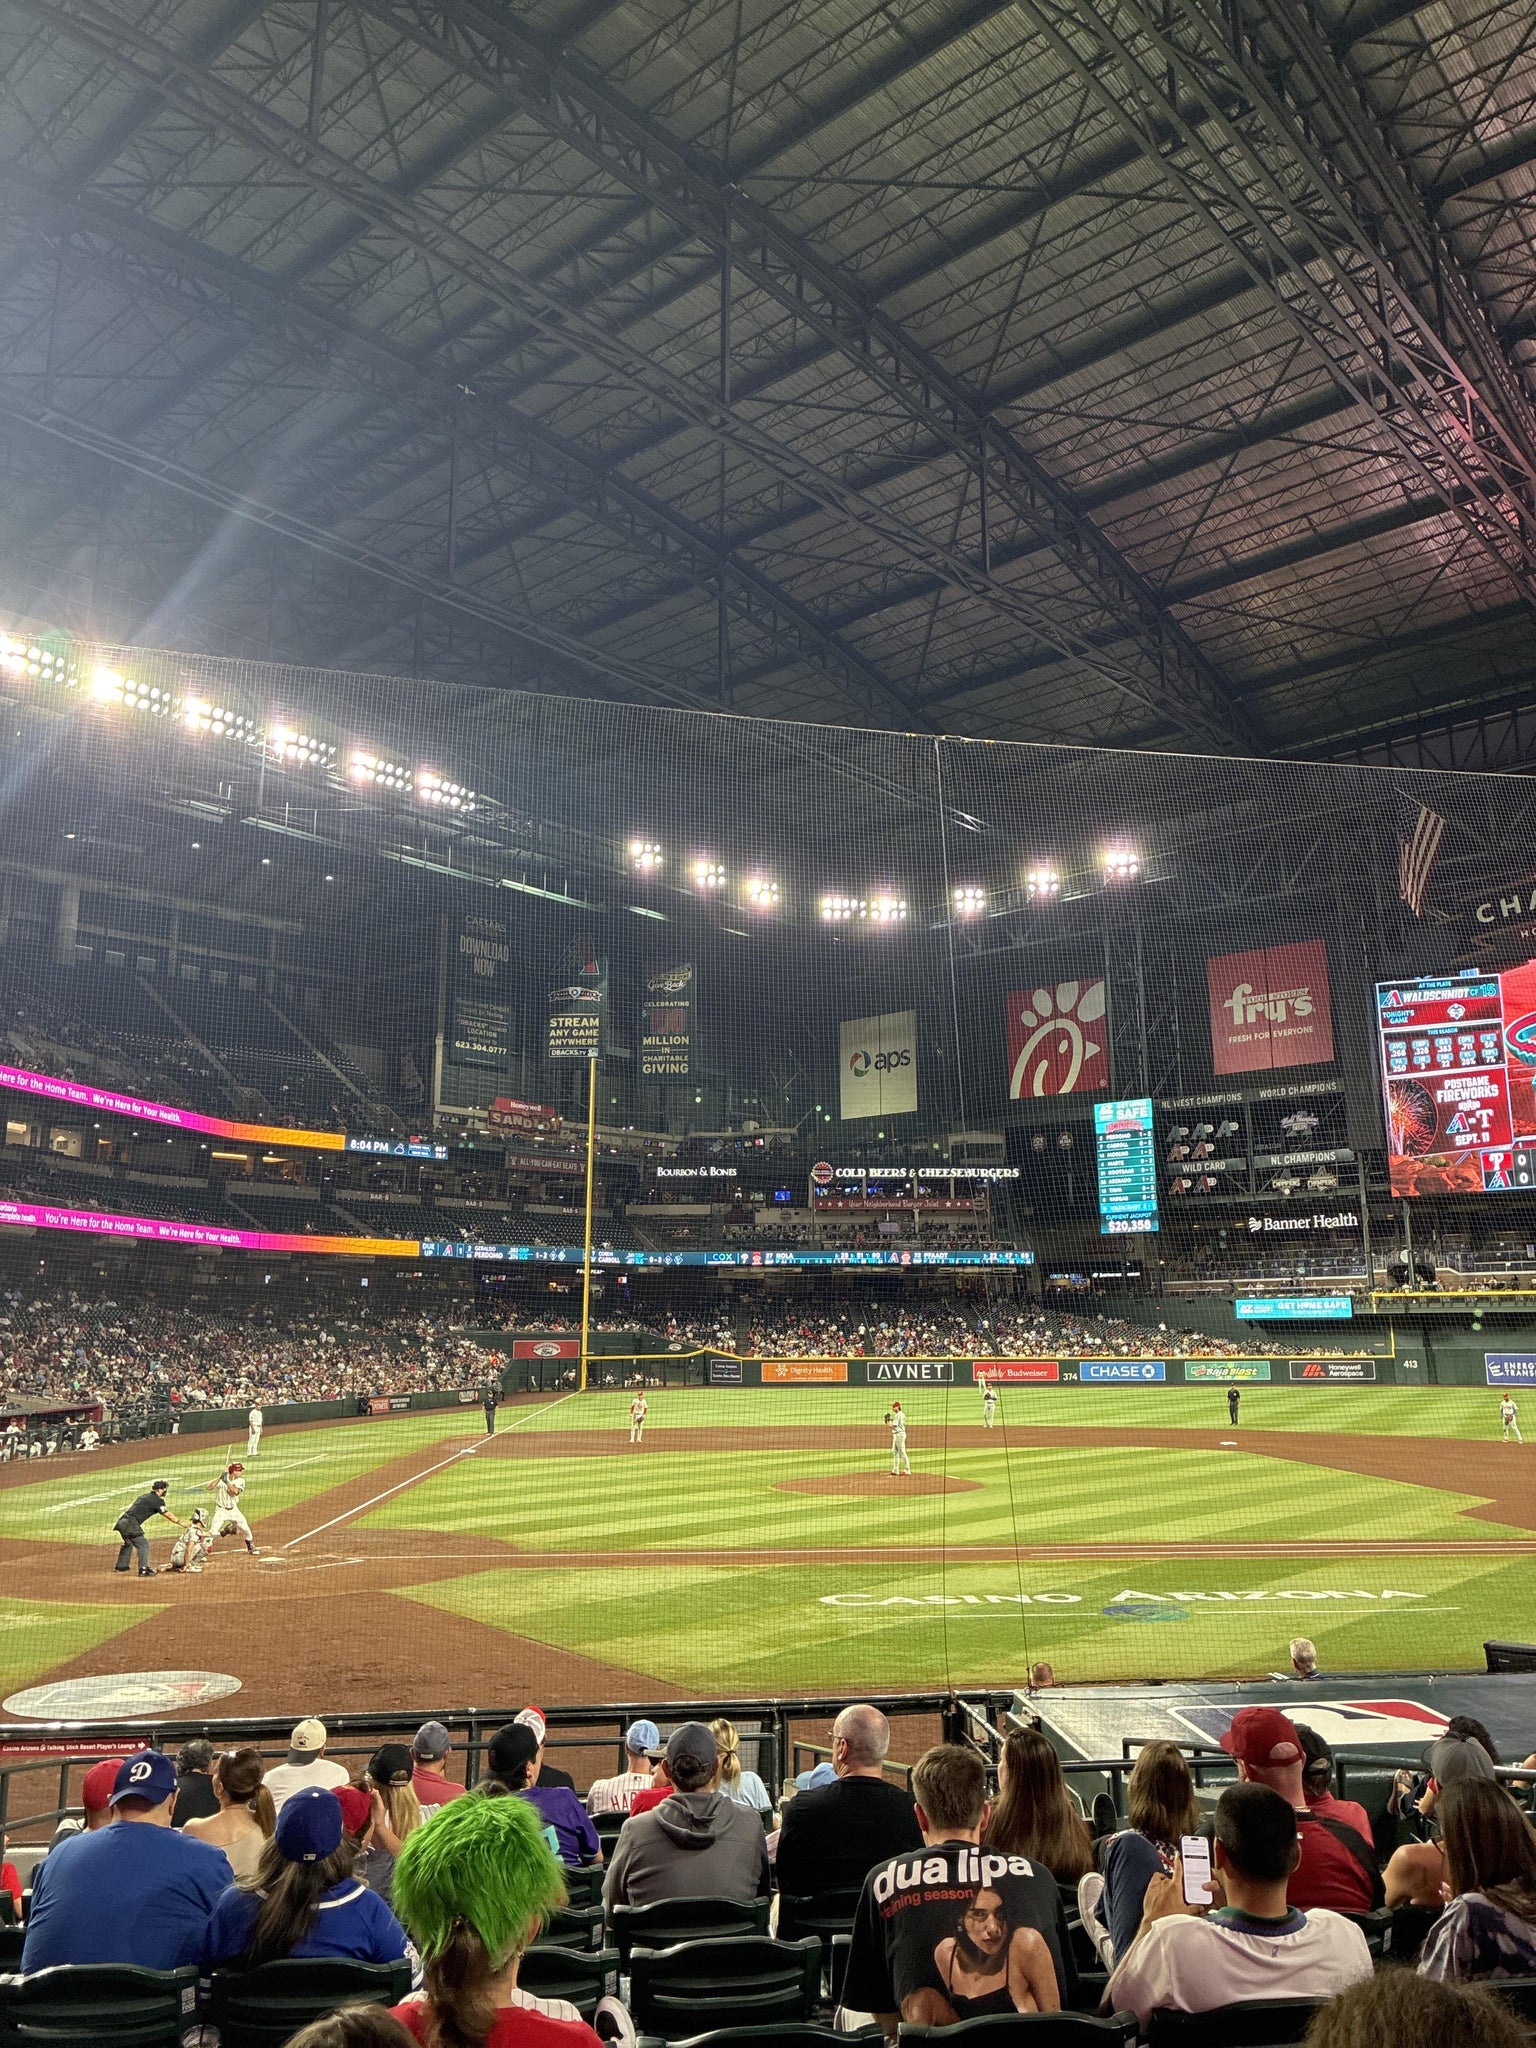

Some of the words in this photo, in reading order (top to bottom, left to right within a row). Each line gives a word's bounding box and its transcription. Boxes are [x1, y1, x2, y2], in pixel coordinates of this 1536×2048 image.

[460, 935, 510, 962] DOWNLOAD
[473, 957, 495, 977] NOW
[1271, 988, 1308, 999] STORES
[1403, 988, 1470, 1003] WALDSCHMIDT
[1469, 988, 1479, 996] CF
[1480, 983, 1496, 997] 15
[1223, 983, 1313, 1025] fry's
[1382, 1010, 1415, 1018] TONIGHT'S
[549, 1017, 600, 1027] STREAM
[467, 1028, 498, 1038] LOCATION
[549, 1029, 570, 1037] ANY
[1228, 1035, 1252, 1043] FRESH
[1254, 1032, 1270, 1040] FOR
[1273, 1026, 1314, 1038] EVERYONE
[549, 1038, 599, 1046] ANYWHERE
[642, 1036, 690, 1045] MILLION
[455, 1041, 508, 1055] 623.304.0777
[874, 1049, 911, 1073] aps
[642, 1063, 689, 1074] GIVING
[1444, 1075, 1490, 1090] POSTGAME
[1259, 1087, 1286, 1098] WORLD
[1288, 1082, 1337, 1096] CHAMPIONS
[1436, 1084, 1499, 1103] FIREWORKS
[17, 1074, 28, 1087] for
[30, 1078, 43, 1090] the
[45, 1082, 66, 1096] Home
[68, 1088, 88, 1101] Team.
[93, 1093, 113, 1107] We're
[115, 1098, 131, 1111] Here
[132, 1101, 142, 1113] for
[143, 1105, 158, 1117] Your
[159, 1109, 182, 1123] Health.
[1173, 1098, 1194, 1107] WEST
[1196, 1093, 1242, 1105] CHAMPIONS
[510, 1101, 541, 1112] Honeywell
[1455, 1133, 1480, 1146] SEPT.
[1481, 1132, 1490, 1143] 11
[350, 1139, 372, 1150] 8:04
[373, 1141, 388, 1152] PM
[519, 1157, 562, 1169] ALL-YOU-CAN-EAT
[562, 1161, 578, 1170] SEATS
[1271, 1156, 1282, 1165] NL
[1284, 1151, 1337, 1164] CHAMPIONS
[1517, 1154, 1527, 1166] 0
[657, 1166, 698, 1176] BOURBON
[700, 1166, 708, 1176] &
[710, 1166, 738, 1176] BONES
[1182, 1163, 1202, 1173] WILD
[1204, 1161, 1226, 1171] CARD
[835, 1168, 867, 1178] COLD
[869, 1168, 907, 1178] BEERS
[909, 1168, 917, 1177] &
[918, 1168, 1020, 1179] CHEESEBURGERS
[1519, 1172, 1529, 1183] 0
[863, 1200, 901, 1208] Neighborhood
[902, 1200, 923, 1208] Burger
[924, 1199, 940, 1207] Joint
[45, 1212, 69, 1225] You're
[70, 1215, 88, 1227] Here
[89, 1217, 99, 1228] for
[101, 1218, 113, 1230] the
[114, 1220, 134, 1232] Home
[136, 1222, 154, 1235] Team.
[159, 1225, 178, 1237] We're
[179, 1228, 194, 1238] Here
[195, 1229, 204, 1239] for
[205, 1231, 219, 1241] Your
[220, 1233, 241, 1243] Health.
[1108, 1219, 1152, 1232] $20,358
[1264, 1217, 1311, 1231] Banner
[1313, 1213, 1358, 1228] Health
[422, 1242, 435, 1250] DUE
[424, 1249, 433, 1257] UP
[474, 1251, 503, 1259] PERDOMO
[598, 1256, 620, 1264] CARROLL
[712, 1253, 732, 1261] COX
[1278, 1301, 1295, 1309] GET
[1323, 1301, 1347, 1309] SAFE
[1403, 1360, 1419, 1368] 413
[790, 1366, 812, 1375] Dignity
[877, 1364, 944, 1379] AVNET
[1090, 1366, 1140, 1377] CHASE
[1007, 1369, 1048, 1377] Budweiser
[1205, 1367, 1230, 1376] Baja
[1230, 1367, 1258, 1376] Blast
[1063, 1372, 1078, 1381] 374
[1328, 1369, 1364, 1377] Aerospace
[818, 1594, 1082, 1606] CASINO
[1110, 1589, 1428, 1602] ARIZONA
[47, 1744, 65, 1752] Talking
[129, 1761, 153, 1783] D
[873, 1856, 948, 1904] dua
[958, 1847, 1034, 1888] lipa
[924, 1888, 974, 1901] season
